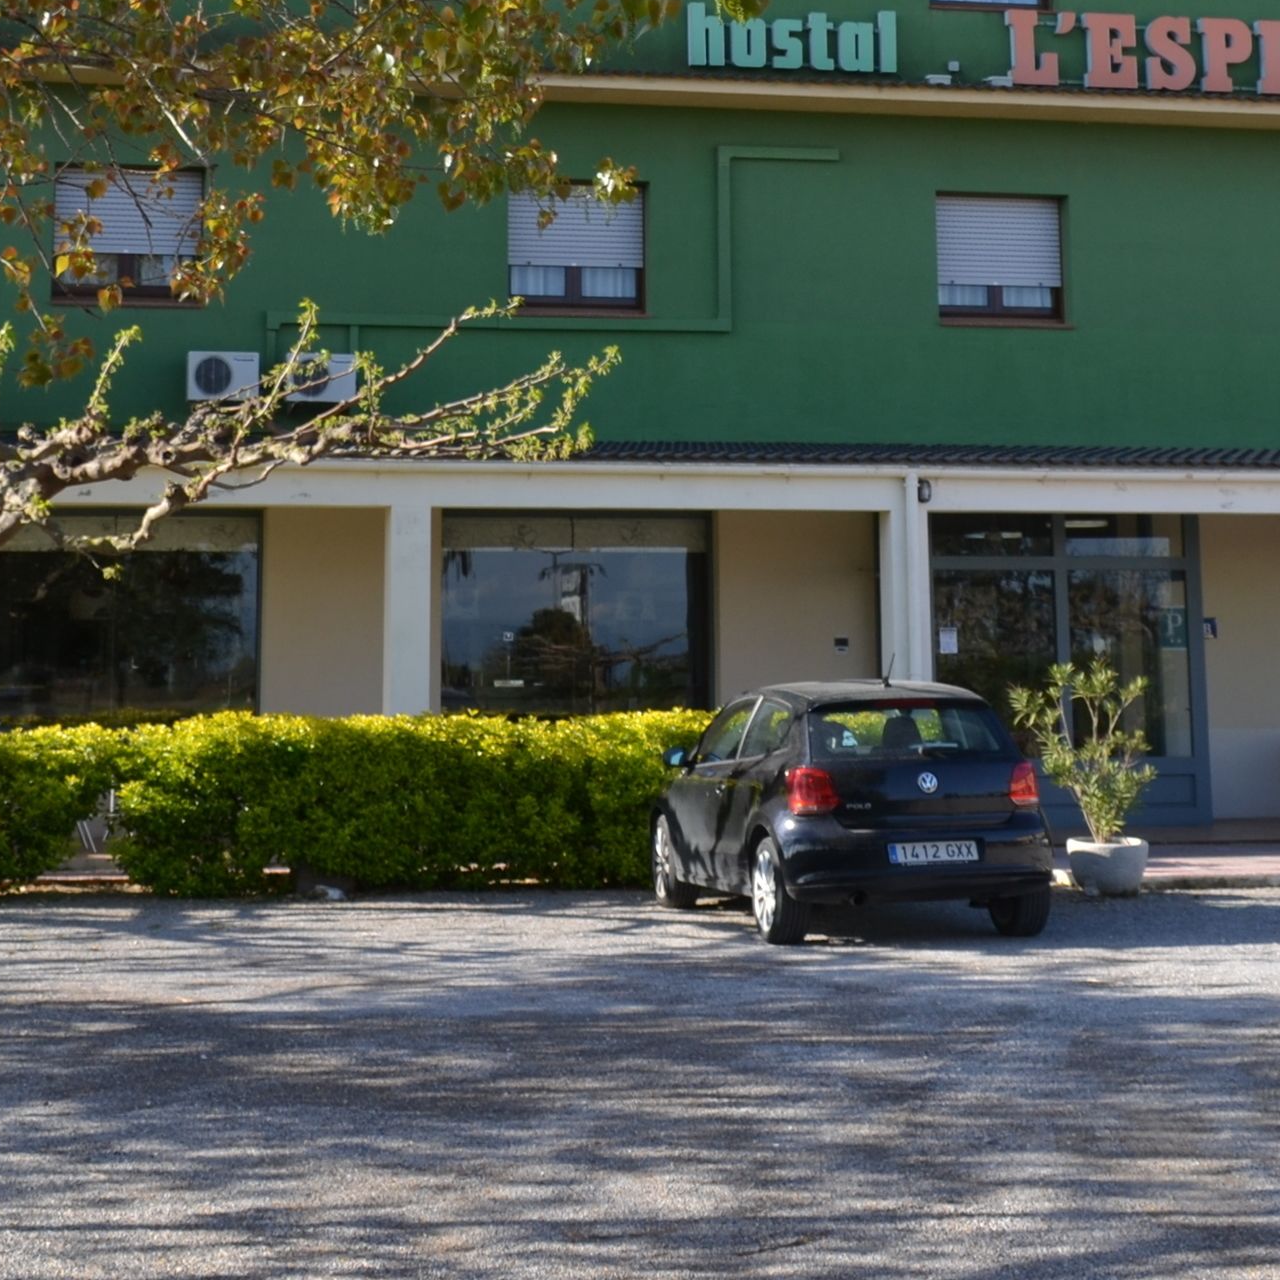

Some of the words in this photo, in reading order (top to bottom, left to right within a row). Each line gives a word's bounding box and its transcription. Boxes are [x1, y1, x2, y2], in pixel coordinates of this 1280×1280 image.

[687, 2, 897, 73] hostal
[901, 844, 941, 860] 1412
[945, 843, 974, 858] GXX
